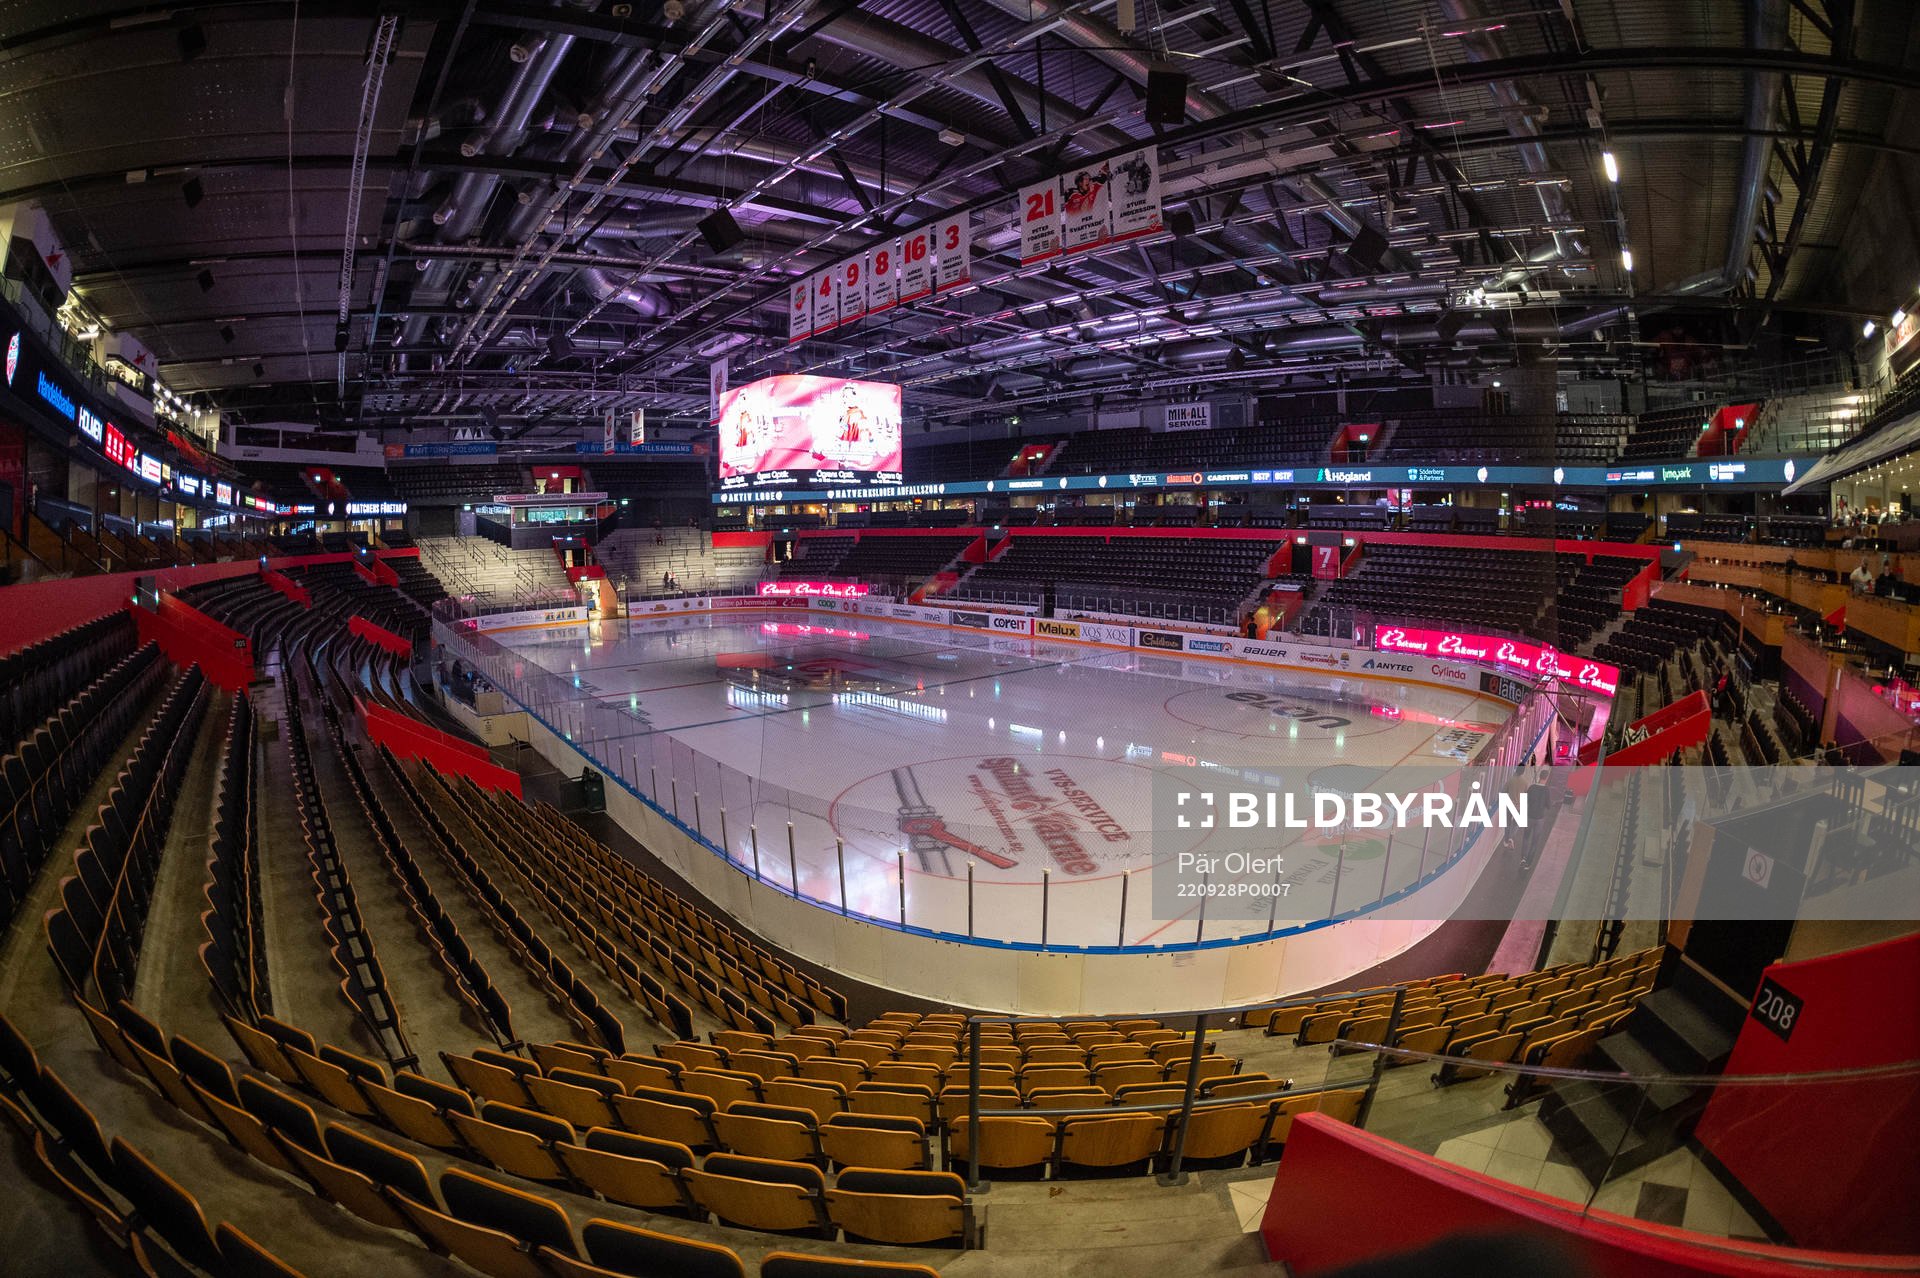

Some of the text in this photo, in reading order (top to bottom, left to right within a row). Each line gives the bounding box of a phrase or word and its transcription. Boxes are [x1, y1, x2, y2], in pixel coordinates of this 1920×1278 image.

[1027, 188, 1053, 222] 21
[1127, 200, 1146, 208] STURE
[1120, 205, 1156, 218] ANDERSSON
[945, 224, 959, 249] 3
[1028, 230, 1054, 242] FORSBERG
[1032, 225, 1048, 234] PETER
[904, 235, 926, 264] 16
[876, 251, 888, 275] 8
[847, 264, 859, 286] 9
[820, 276, 831, 296] 4
[1168, 407, 1206, 420] MIK ALL
[79, 405, 102, 442] HOLMEN
[1168, 420, 1207, 428] SERVICE
[1332, 471, 1371, 482] Högland
[728, 493, 752, 502] AKTIV
[1319, 548, 1332, 568] 7
[818, 600, 836, 608] coop
[994, 618, 1026, 630] coreIT
[1039, 623, 1076, 636] Malux
[1082, 626, 1100, 640] XQS
[1106, 628, 1127, 643] XQS
[1376, 662, 1413, 672] ANYTEC
[1432, 665, 1466, 680] Cylinda
[1044, 768, 1131, 842] VVS-SERVICE
[1758, 988, 1795, 1029] 208
